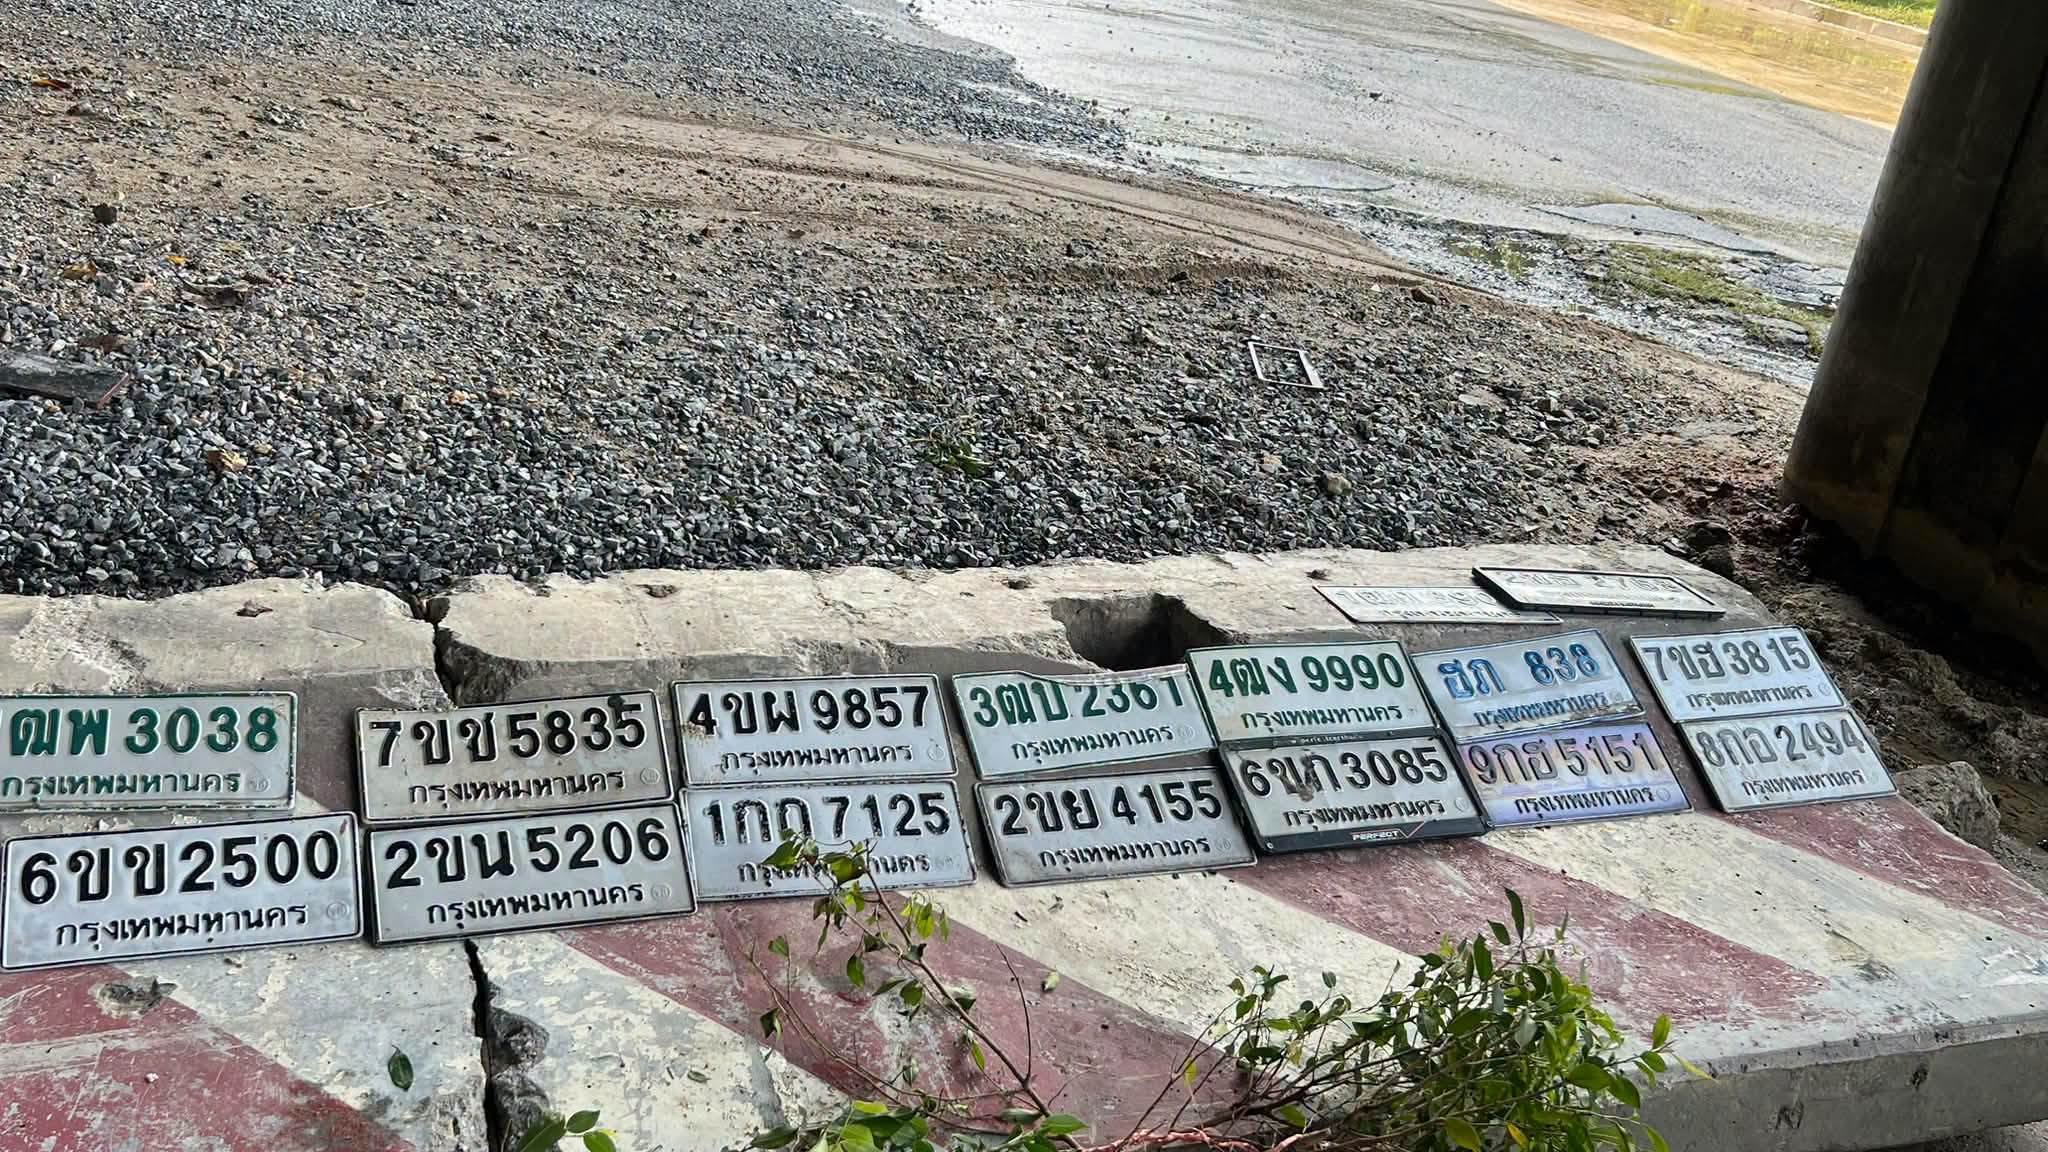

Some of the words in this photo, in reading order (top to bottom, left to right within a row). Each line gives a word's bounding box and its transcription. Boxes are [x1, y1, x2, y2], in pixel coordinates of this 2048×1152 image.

[1301, 653, 1405, 693] 9990
[1523, 643, 1599, 686] 838
[1722, 636, 1811, 675] 3815
[125, 706, 278, 755] 3038
[689, 690, 800, 735] 4ขผ
[812, 686, 929, 730] 9857
[1241, 704, 1402, 732] กรุงเทพมหานคร
[370, 712, 497, 767] 7ขช
[507, 702, 646, 759] 5835
[1011, 726, 1174, 763] กรุงเทพมหานคร
[1555, 732, 1658, 777] 5151
[1696, 727, 1779, 768] 8กอ
[1774, 719, 1866, 761] 2494
[722, 745, 912, 774] กรุงเทพมหานคร
[1341, 746, 1448, 790] 3085
[2, 772, 241, 799] กรุงเทพมหานคร
[410, 770, 625, 808] กรุงเทพมหานคร
[1515, 787, 1654, 818] กรุงเทพมหานคร
[1740, 769, 1866, 800] กรุงเทพมหานคร
[822, 792, 951, 838] 7125
[994, 790, 1100, 836] 2ขย
[1112, 780, 1222, 826] 4155
[1283, 799, 1445, 830] กรุงเทพมหานคร
[385, 831, 514, 889] 2ขน
[527, 818, 671, 873] 5206
[1039, 837, 1211, 872] กรุงเทพมหานคร
[1352, 830, 1399, 841] PERFECT
[20, 846, 166, 905] 6ขข
[180, 830, 340, 893] 2500
[56, 904, 308, 950] กรุงเทพมหานคร
[427, 884, 644, 928] กรุงเทพมหานคร
